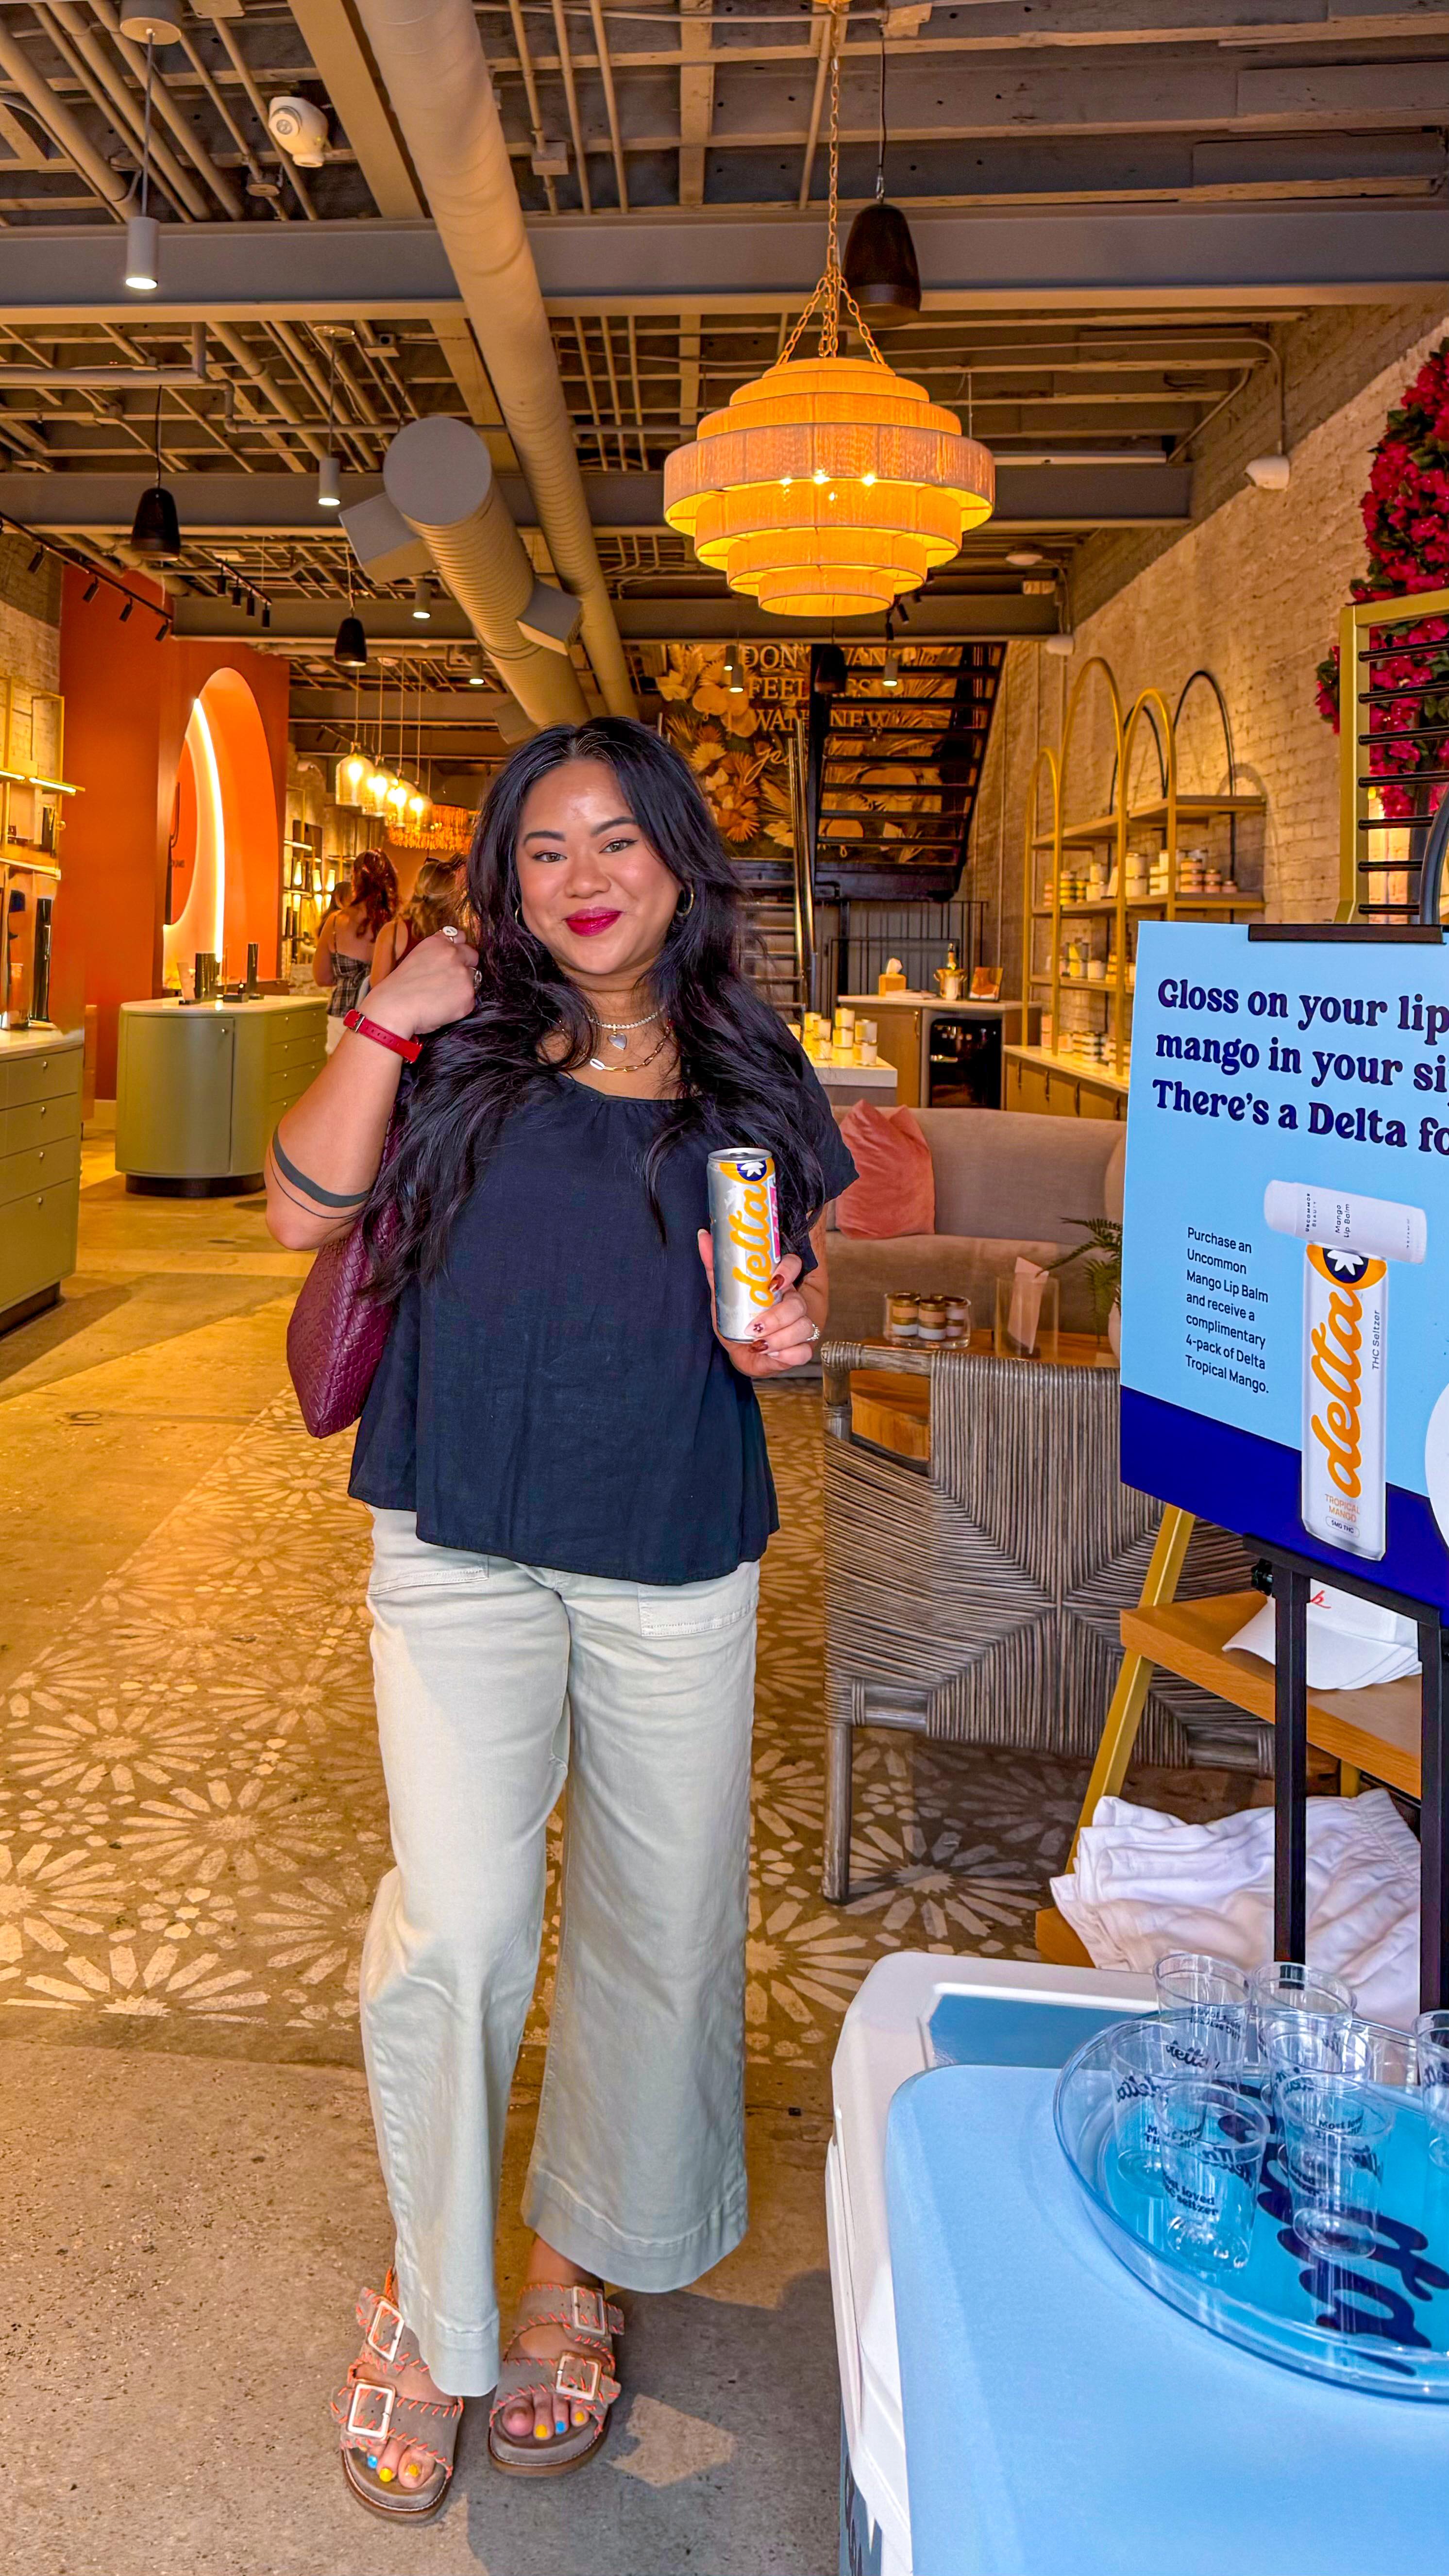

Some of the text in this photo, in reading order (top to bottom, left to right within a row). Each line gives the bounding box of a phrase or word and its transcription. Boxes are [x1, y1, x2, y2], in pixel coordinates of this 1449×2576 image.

[1158, 979, 1239, 1014] Gloss
[1247, 991, 1288, 1018] on
[1297, 994, 1387, 1031] your
[1156, 1034, 1449, 1106] mango in your si
[1152, 1080, 1269, 1126] There's
[1278, 1104, 1298, 1130] a
[1308, 1102, 1407, 1148] Delta
[728, 1184, 775, 1308] delta
[1188, 1227, 1252, 1254] Purchase an
[1187, 1248, 1247, 1274] Uncommon
[1187, 1269, 1268, 1303] Mango Lip Balm
[1186, 1293, 1255, 1321] and receive a
[1186, 1315, 1265, 1350] complimentary
[1186, 1334, 1265, 1370] 4-pack of Delta
[1185, 1355, 1269, 1393] Tropical Mango.
[1311, 1288, 1363, 1498] delta
[1325, 1494, 1360, 1515] TROPICAL
[1329, 1505, 1357, 1523] MANGO
[1177, 2195, 1219, 2216] seltzer
[1182, 2186, 1214, 2205] loved
